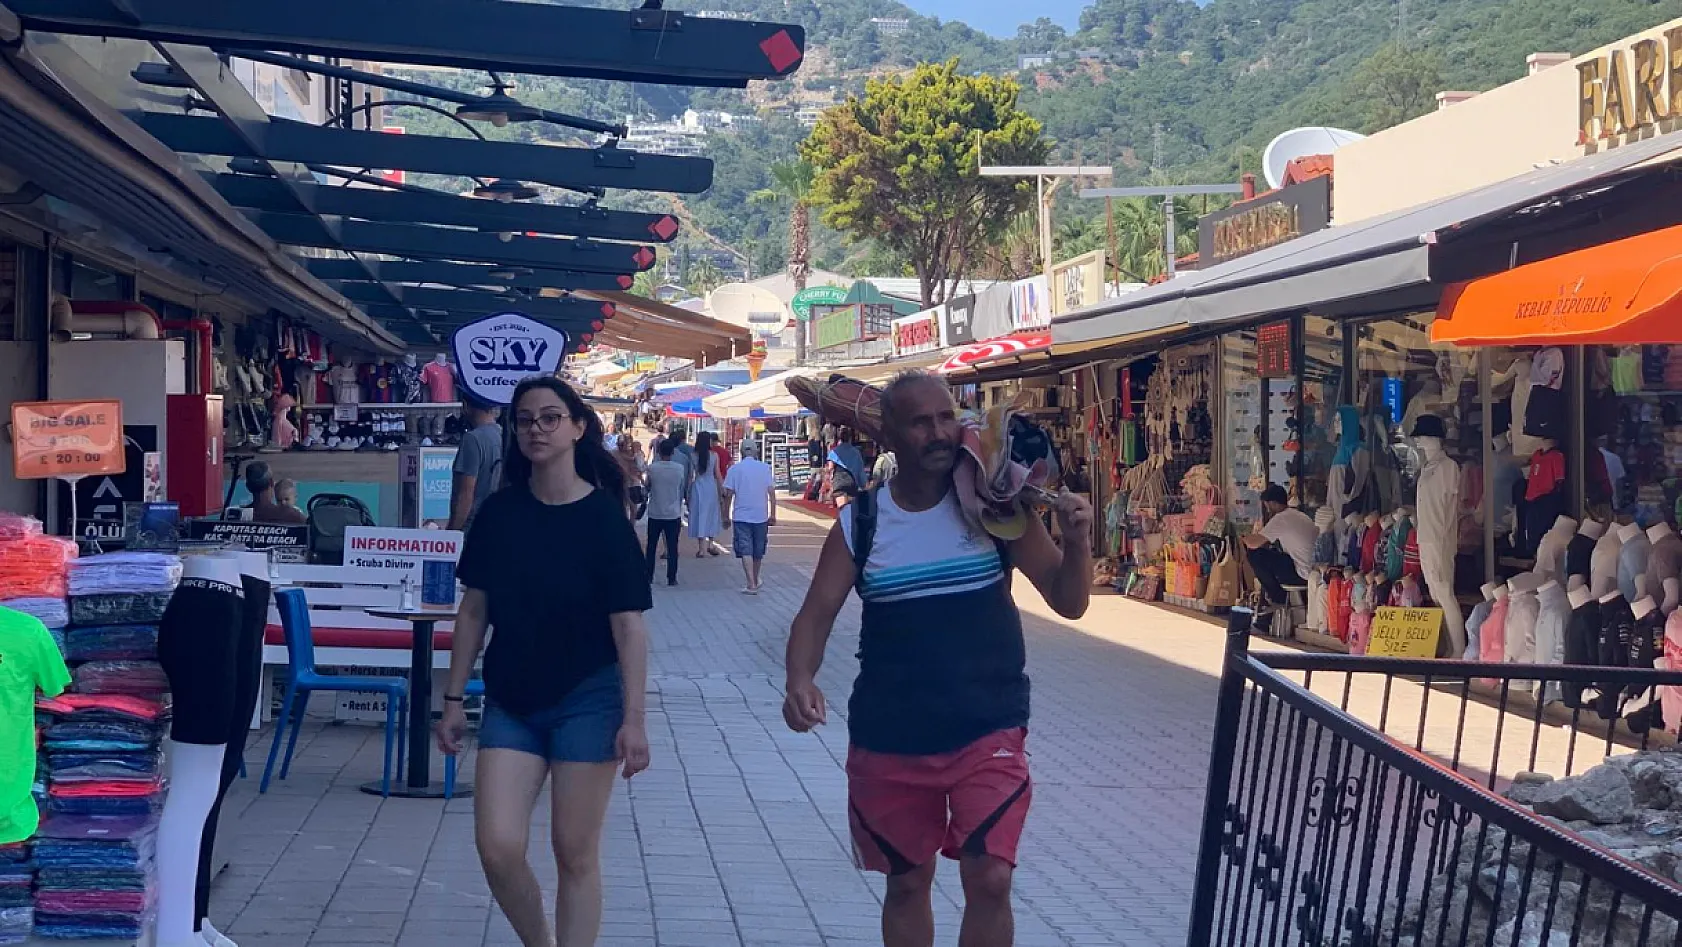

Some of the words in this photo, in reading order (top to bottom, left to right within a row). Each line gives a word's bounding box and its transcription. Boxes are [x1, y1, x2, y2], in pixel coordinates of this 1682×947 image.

[1515, 300, 1552, 319] KEBAB
[470, 337, 548, 371] SKY
[474, 376, 518, 386] Coffee
[30, 416, 58, 429] BIG
[64, 413, 105, 428] SALE
[257, 526, 288, 535] BEACH
[266, 535, 297, 545] BEACH
[351, 536, 456, 554] INFORMATION
[356, 558, 383, 569] Scuba
[209, 582, 232, 593] PRO
[1379, 609, 1397, 621] WE
[1403, 610, 1430, 622] HAVE
[1374, 625, 1400, 640] JELLY
[1405, 627, 1432, 640] BELLY
[1383, 640, 1410, 653] SIZE
[349, 700, 370, 711] Rent
